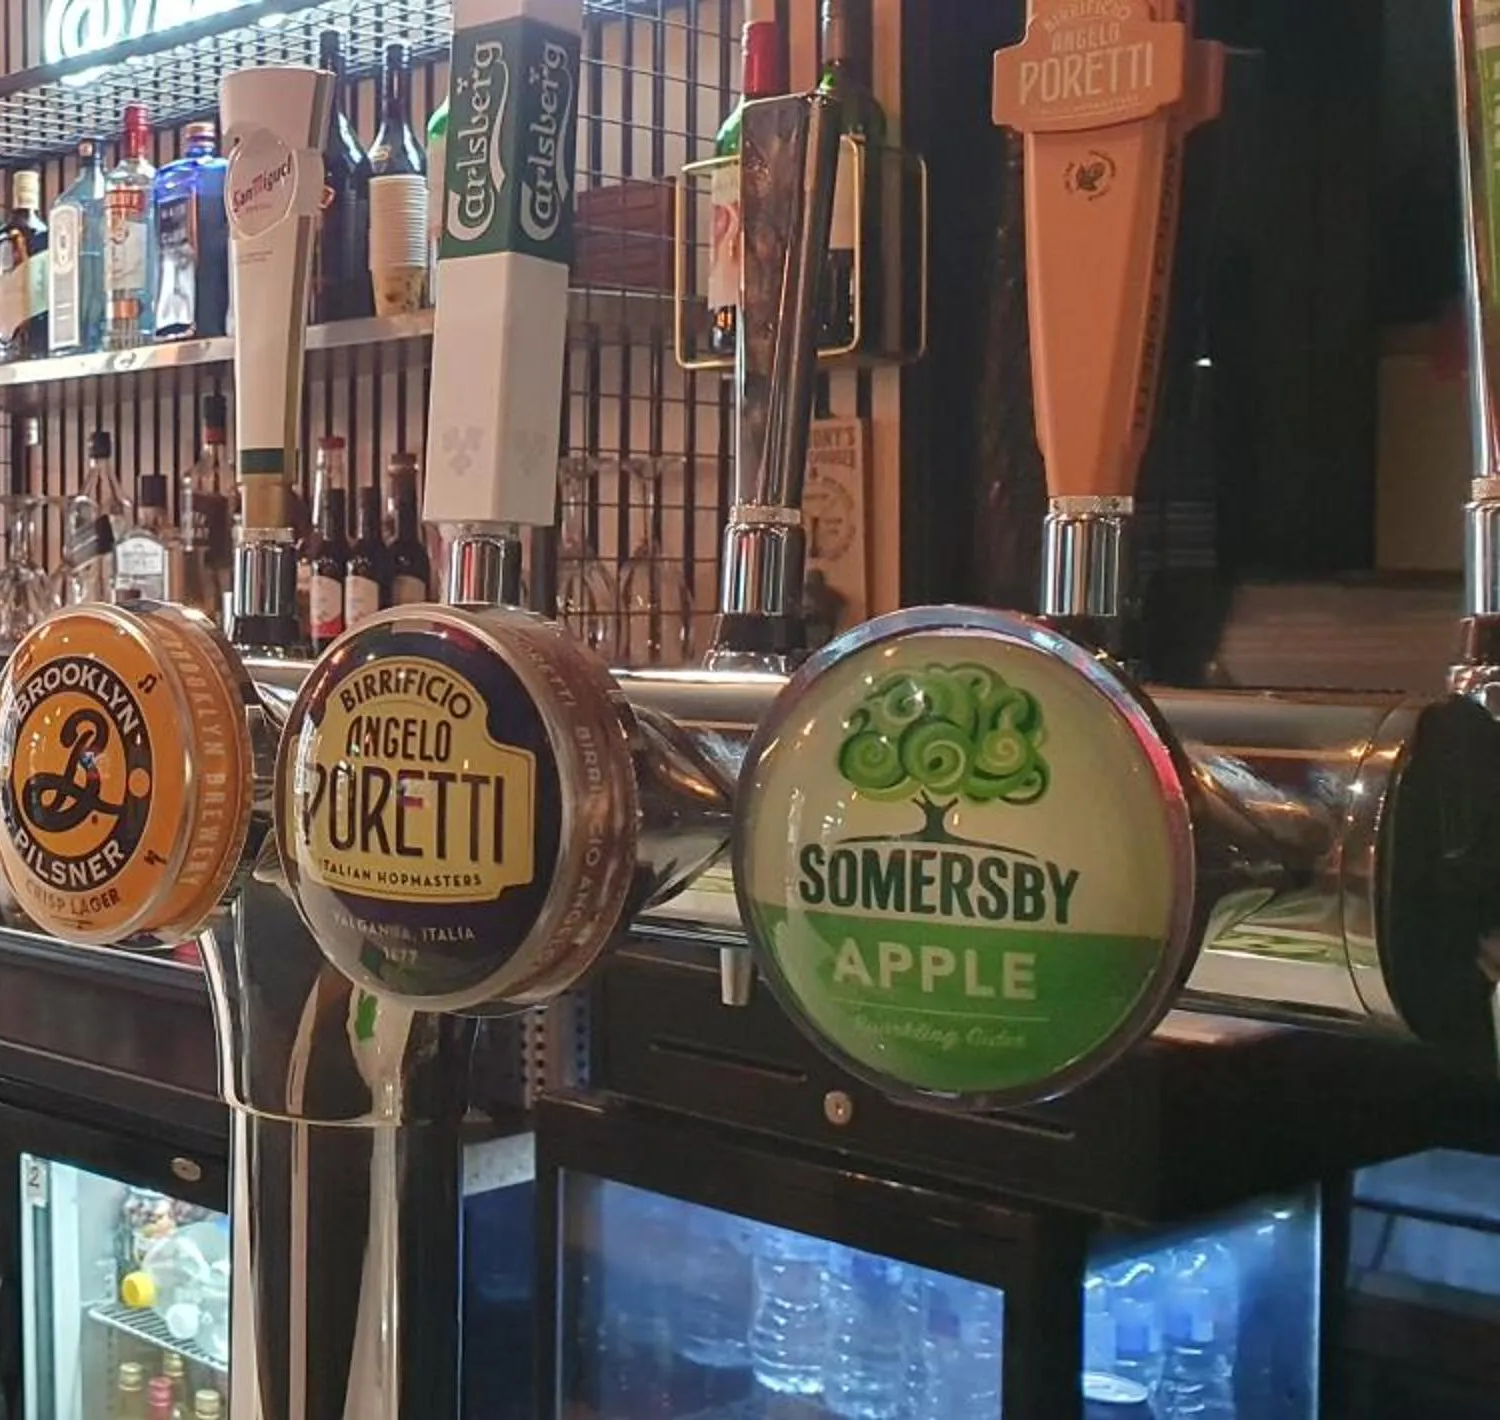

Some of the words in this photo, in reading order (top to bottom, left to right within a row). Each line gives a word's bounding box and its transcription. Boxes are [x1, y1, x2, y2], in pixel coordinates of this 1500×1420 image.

[1052, 22, 1121, 53] ANGELO
[1020, 41, 1155, 106] PORETTI
[446, 40, 509, 242] Carlsberg
[520, 40, 573, 242] Carlsberg
[15, 663, 141, 733] BROOKLYN
[339, 667, 474, 720] BIRRIFICIO
[346, 715, 452, 764] ANGELO
[302, 765, 505, 865] PORETTI
[14, 832, 125, 888] PILSNER
[318, 858, 372, 884] ITALIAN
[377, 871, 483, 887] HOPMASTERS
[800, 842, 1082, 925] SOMERSBY
[70, 887, 121, 915] LAGER
[422, 926, 476, 943] ITALIA
[832, 937, 1038, 1001] APPLE
[26, 1165, 40, 1189] 2
